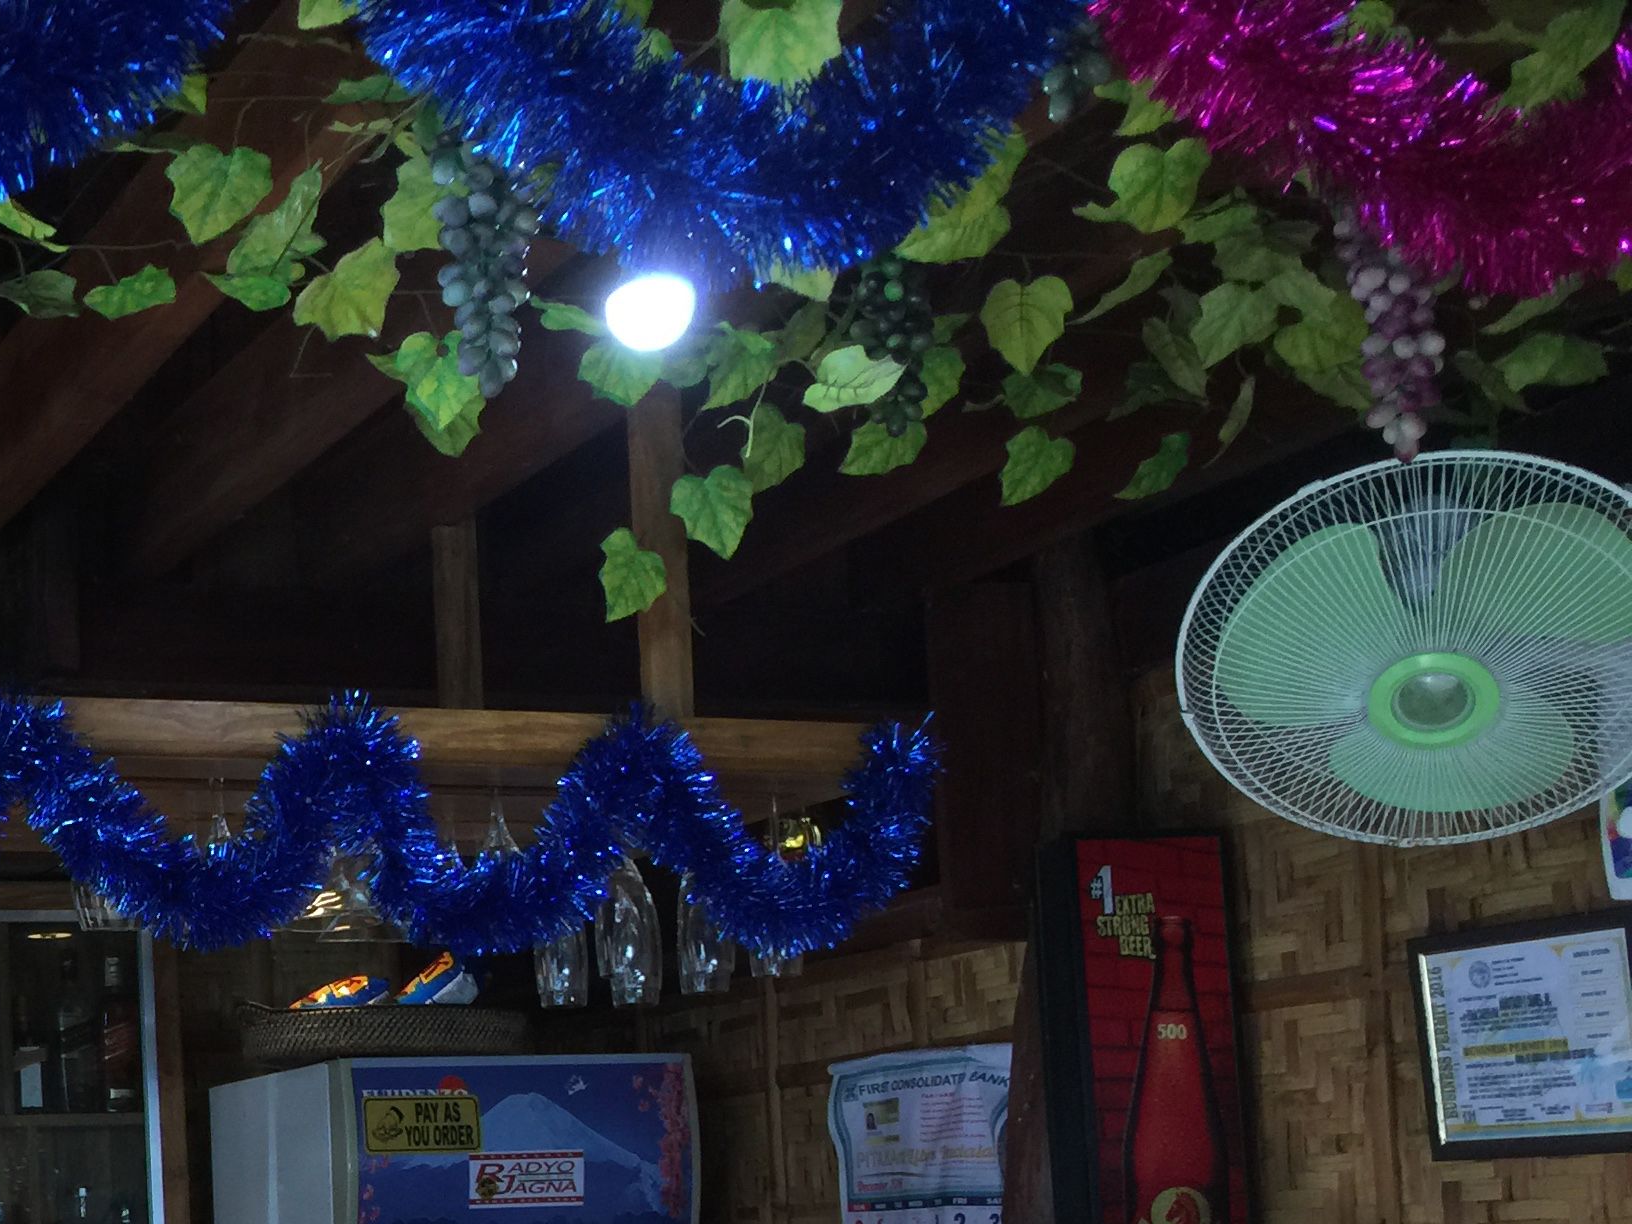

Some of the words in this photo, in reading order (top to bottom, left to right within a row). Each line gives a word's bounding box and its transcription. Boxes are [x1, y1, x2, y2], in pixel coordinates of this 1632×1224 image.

[1114, 892, 1156, 915] EXTRA
[1096, 914, 1150, 937] STRONG
[1430, 966, 1445, 998] 2016
[1156, 1022, 1188, 1041] 500
[968, 1070, 1010, 1089] BANK
[414, 1102, 439, 1123] PAY
[443, 1101, 461, 1122] AS
[404, 1125, 430, 1147] YOU
[433, 1125, 474, 1146] ORDER
[475, 1160, 576, 1184] RADYO
[496, 1174, 578, 1195] JAGNA
[952, 1197, 968, 1205] FRI
